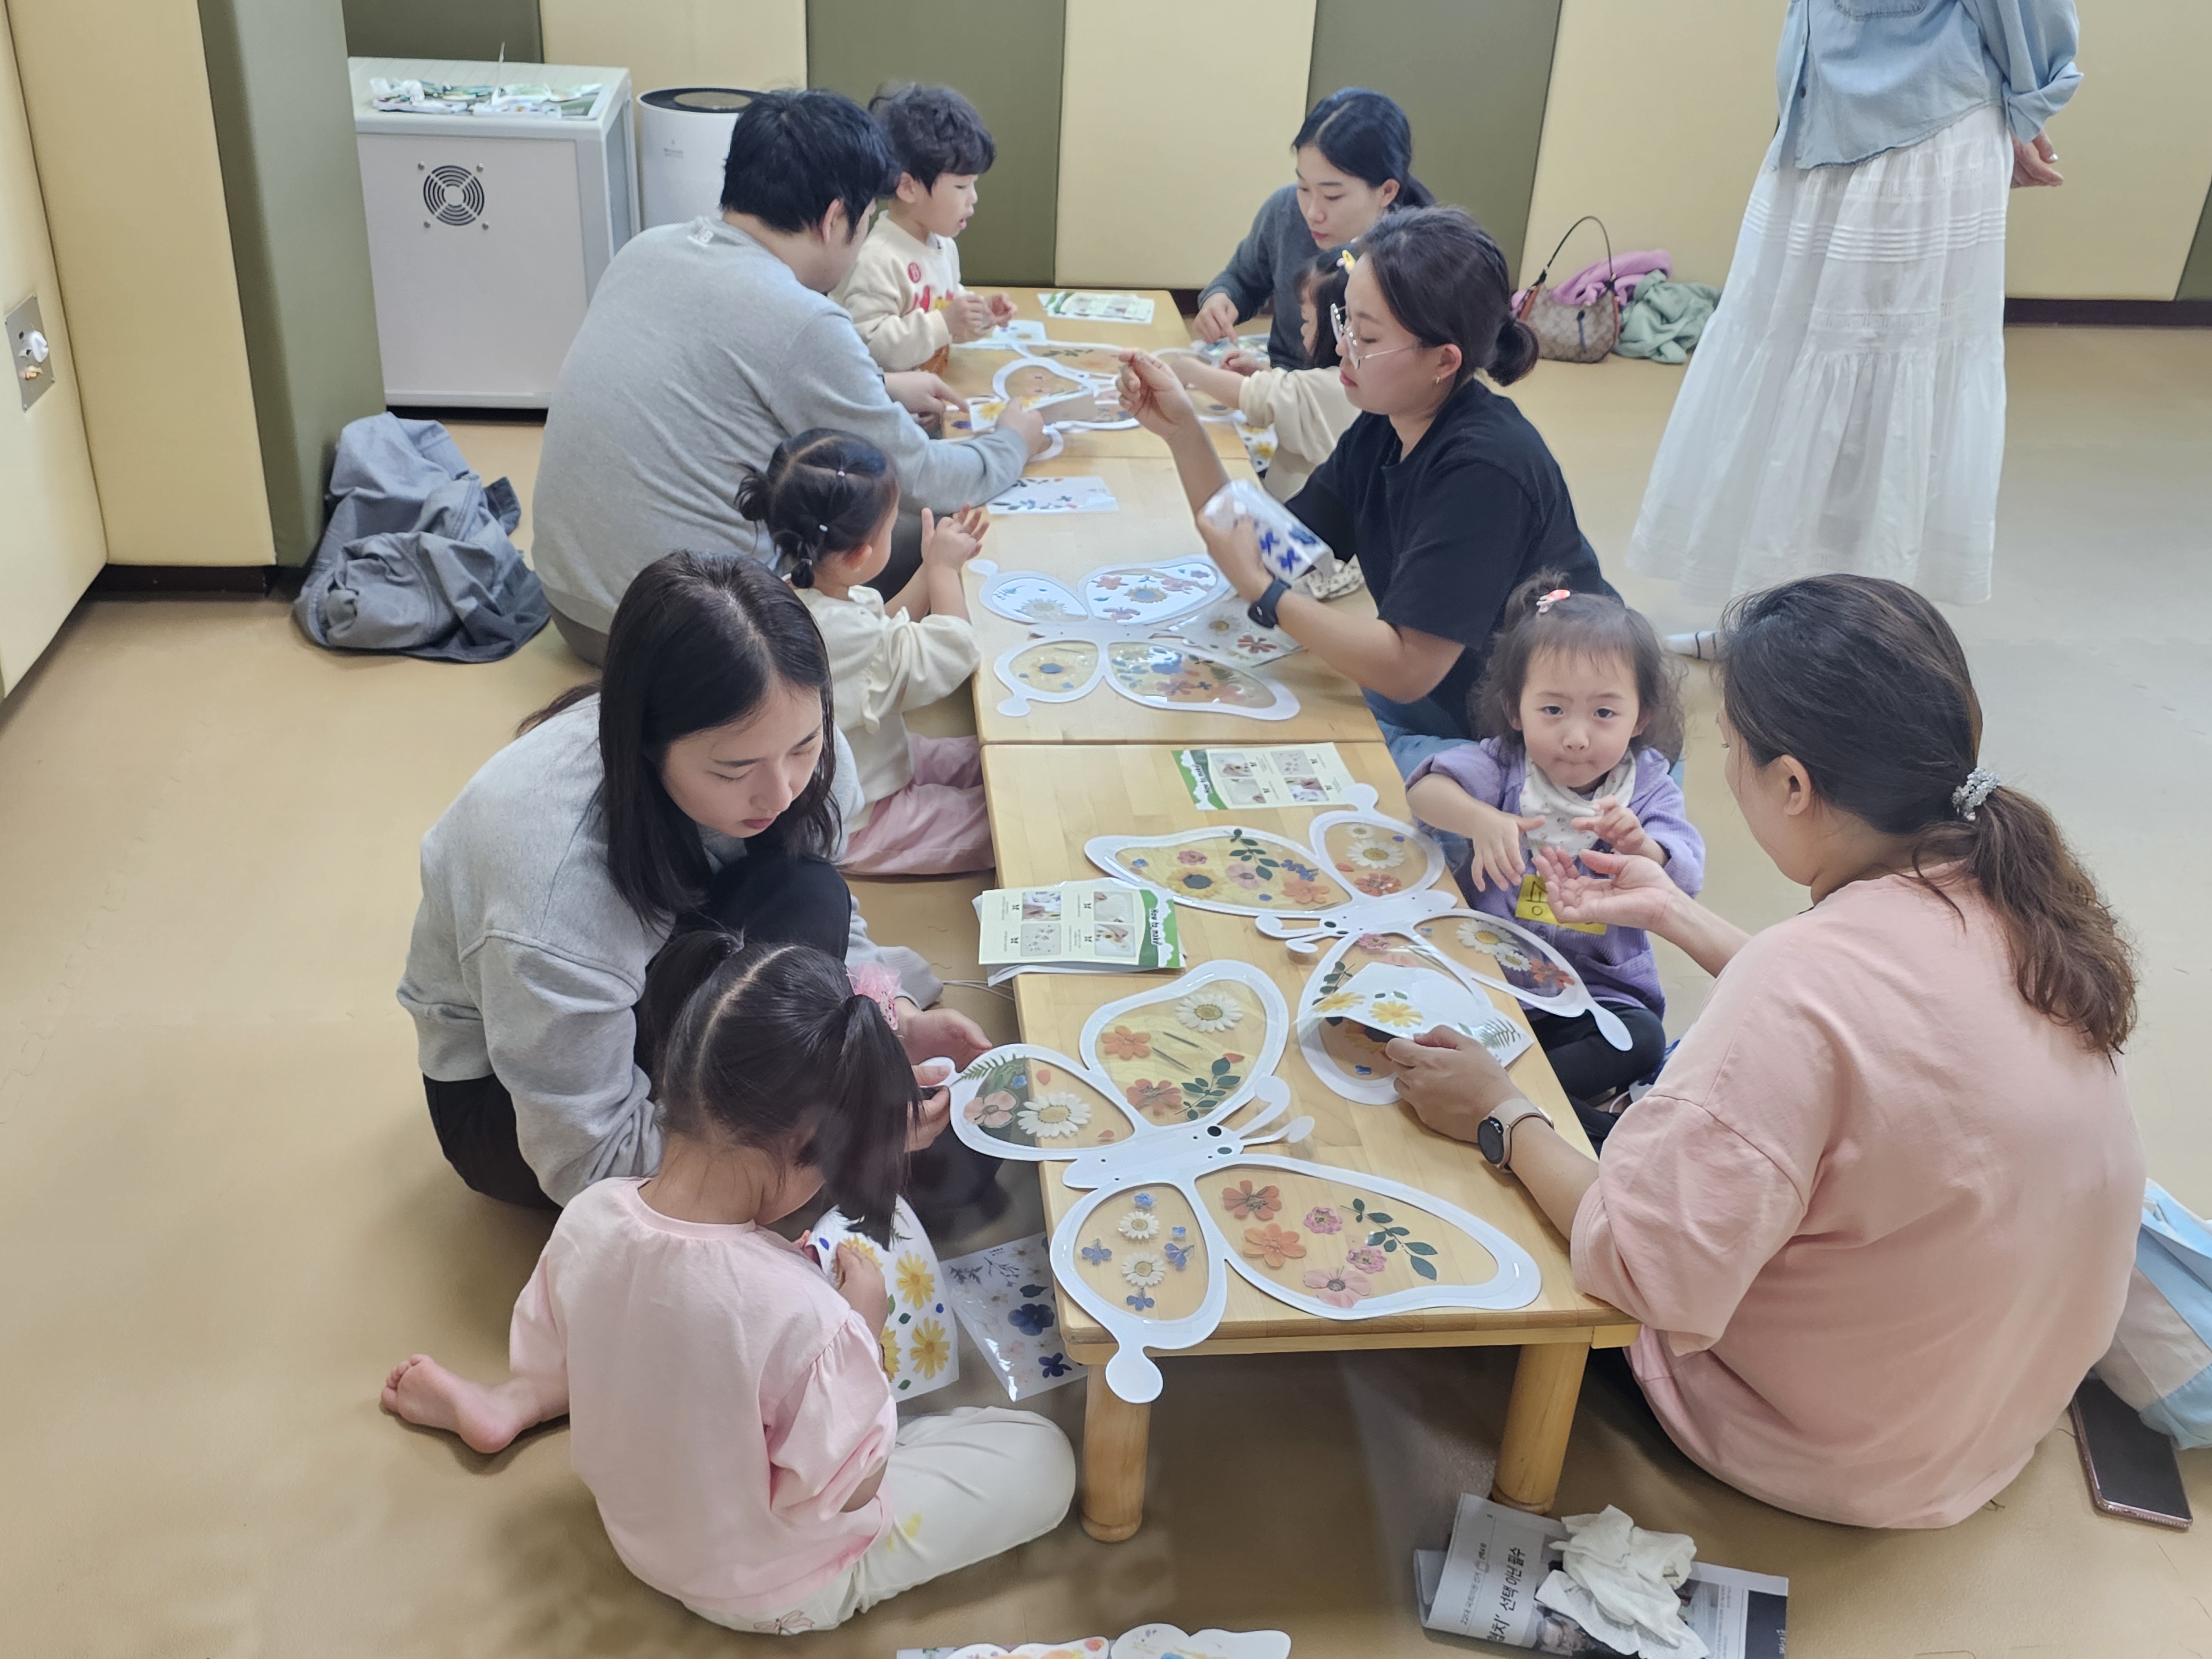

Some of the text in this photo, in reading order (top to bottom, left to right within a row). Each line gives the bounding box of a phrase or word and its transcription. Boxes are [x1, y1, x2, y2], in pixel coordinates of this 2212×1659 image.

[1151, 909, 1159, 921] How
[1507, 1547, 1526, 1567] 필수
[1504, 1564, 1522, 1585] 아닌
[1499, 1584, 1519, 1611] 선택
